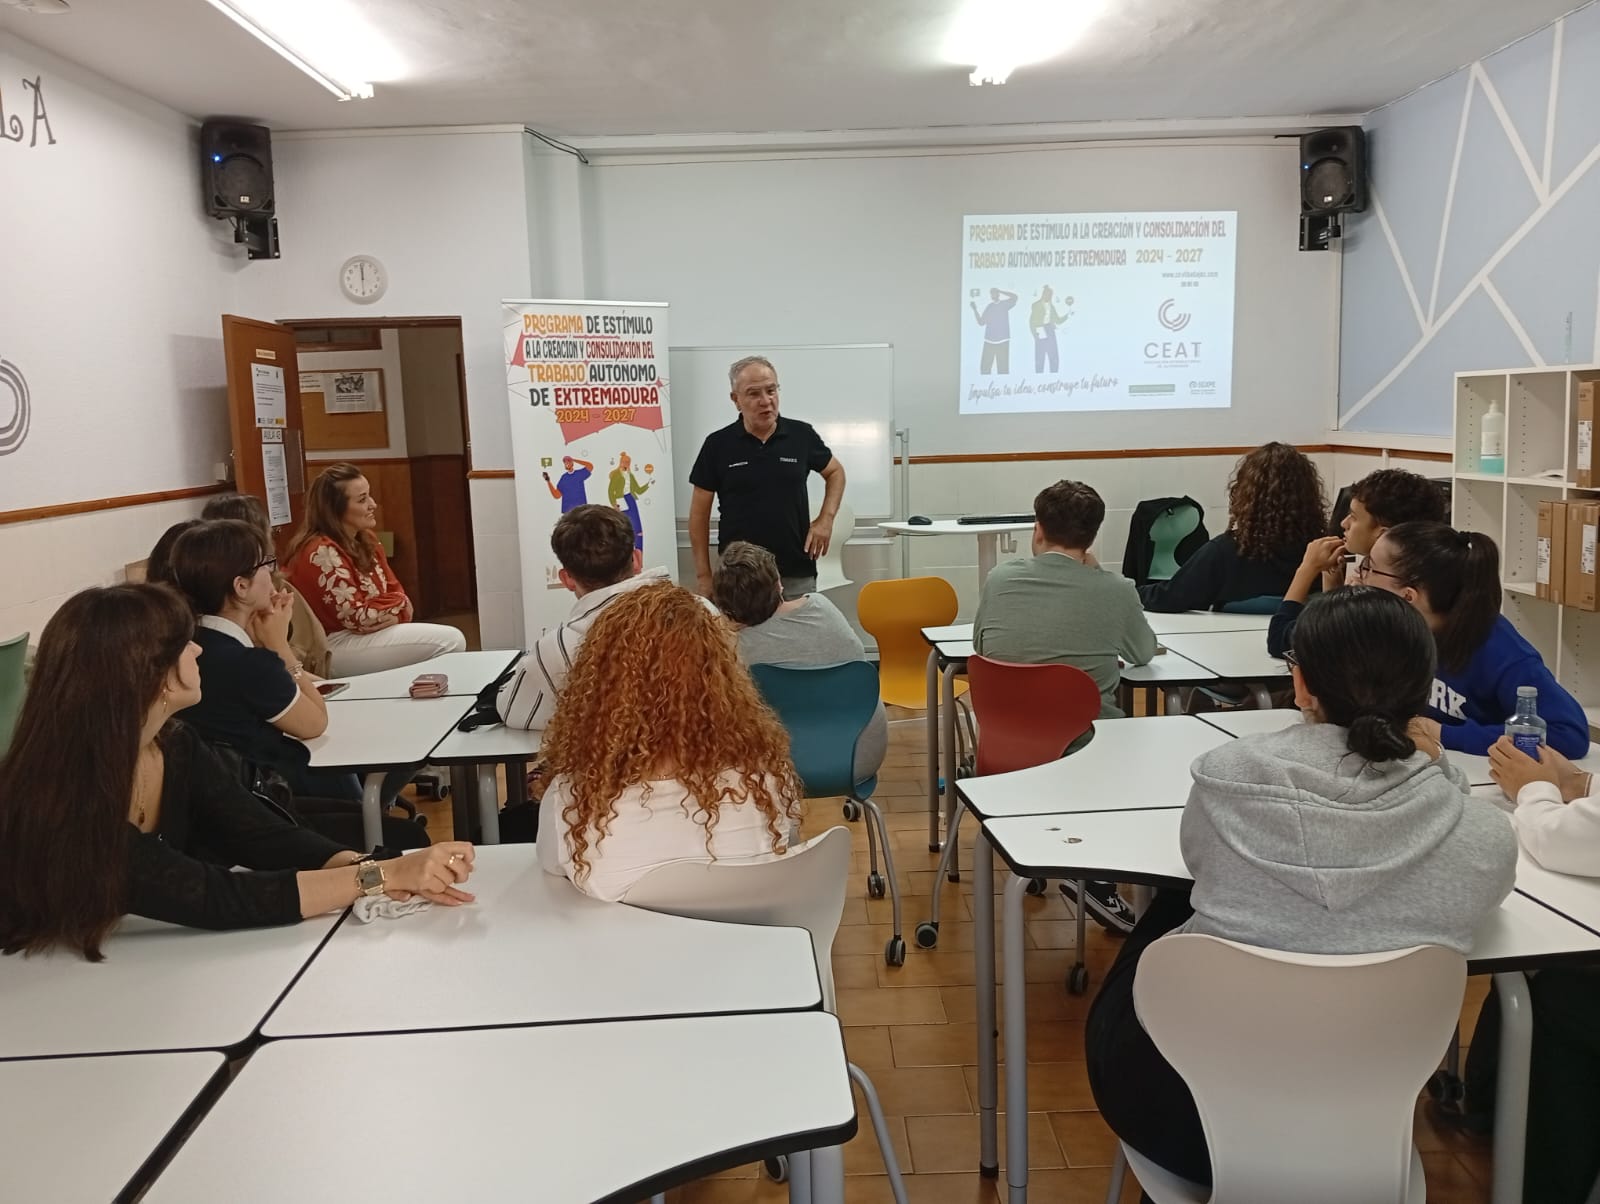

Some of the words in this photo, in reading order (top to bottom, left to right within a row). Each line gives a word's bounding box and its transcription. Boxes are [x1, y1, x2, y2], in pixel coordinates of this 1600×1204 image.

[969, 224, 1015, 242] PROGRAMA
[1017, 222, 1028, 240] DE
[1030, 218, 1070, 240] ESTÍMULO
[1072, 222, 1079, 240] A
[1080, 222, 1090, 239] LA
[1091, 216, 1134, 239] CREACIÓN
[1136, 221, 1142, 238] Y
[1143, 215, 1210, 238] CONSOLIDACIÓN
[1211, 220, 1226, 237] DEL
[969, 252, 1005, 269] TRABAJO
[1008, 247, 1053, 268] AUTÓNOMO
[1054, 250, 1066, 267] DE
[1067, 249, 1127, 266] EXTREMADURA
[1136, 249, 1164, 264] 2024
[1175, 248, 1203, 263] 2027
[523, 314, 584, 335] PROGRAMA
[586, 315, 600, 334] DE
[602, 309, 653, 335] ESTÍMULO
[525, 342, 532, 359] A
[532, 342, 542, 359] LA
[542, 335, 579, 359] CREACIÓN
[580, 342, 585, 359] Y
[585, 336, 641, 359] CONSOLIDACIÓN
[642, 342, 655, 359] DEL
[1144, 342, 1202, 359] CEAT
[527, 364, 585, 383] TRABAJO
[589, 359, 656, 382] AUTÓNOMO
[529, 388, 550, 407] DE
[554, 386, 659, 406] EXTREMADURA
[968, 381, 1001, 405] Impulsa
[1003, 384, 1012, 396] tu
[1037, 380, 1079, 397] construye
[1080, 377, 1089, 390] tu
[1089, 373, 1118, 392] futuro
[556, 409, 590, 424] 2024
[604, 408, 636, 422] 2027
[1428, 677, 1468, 721] RK
